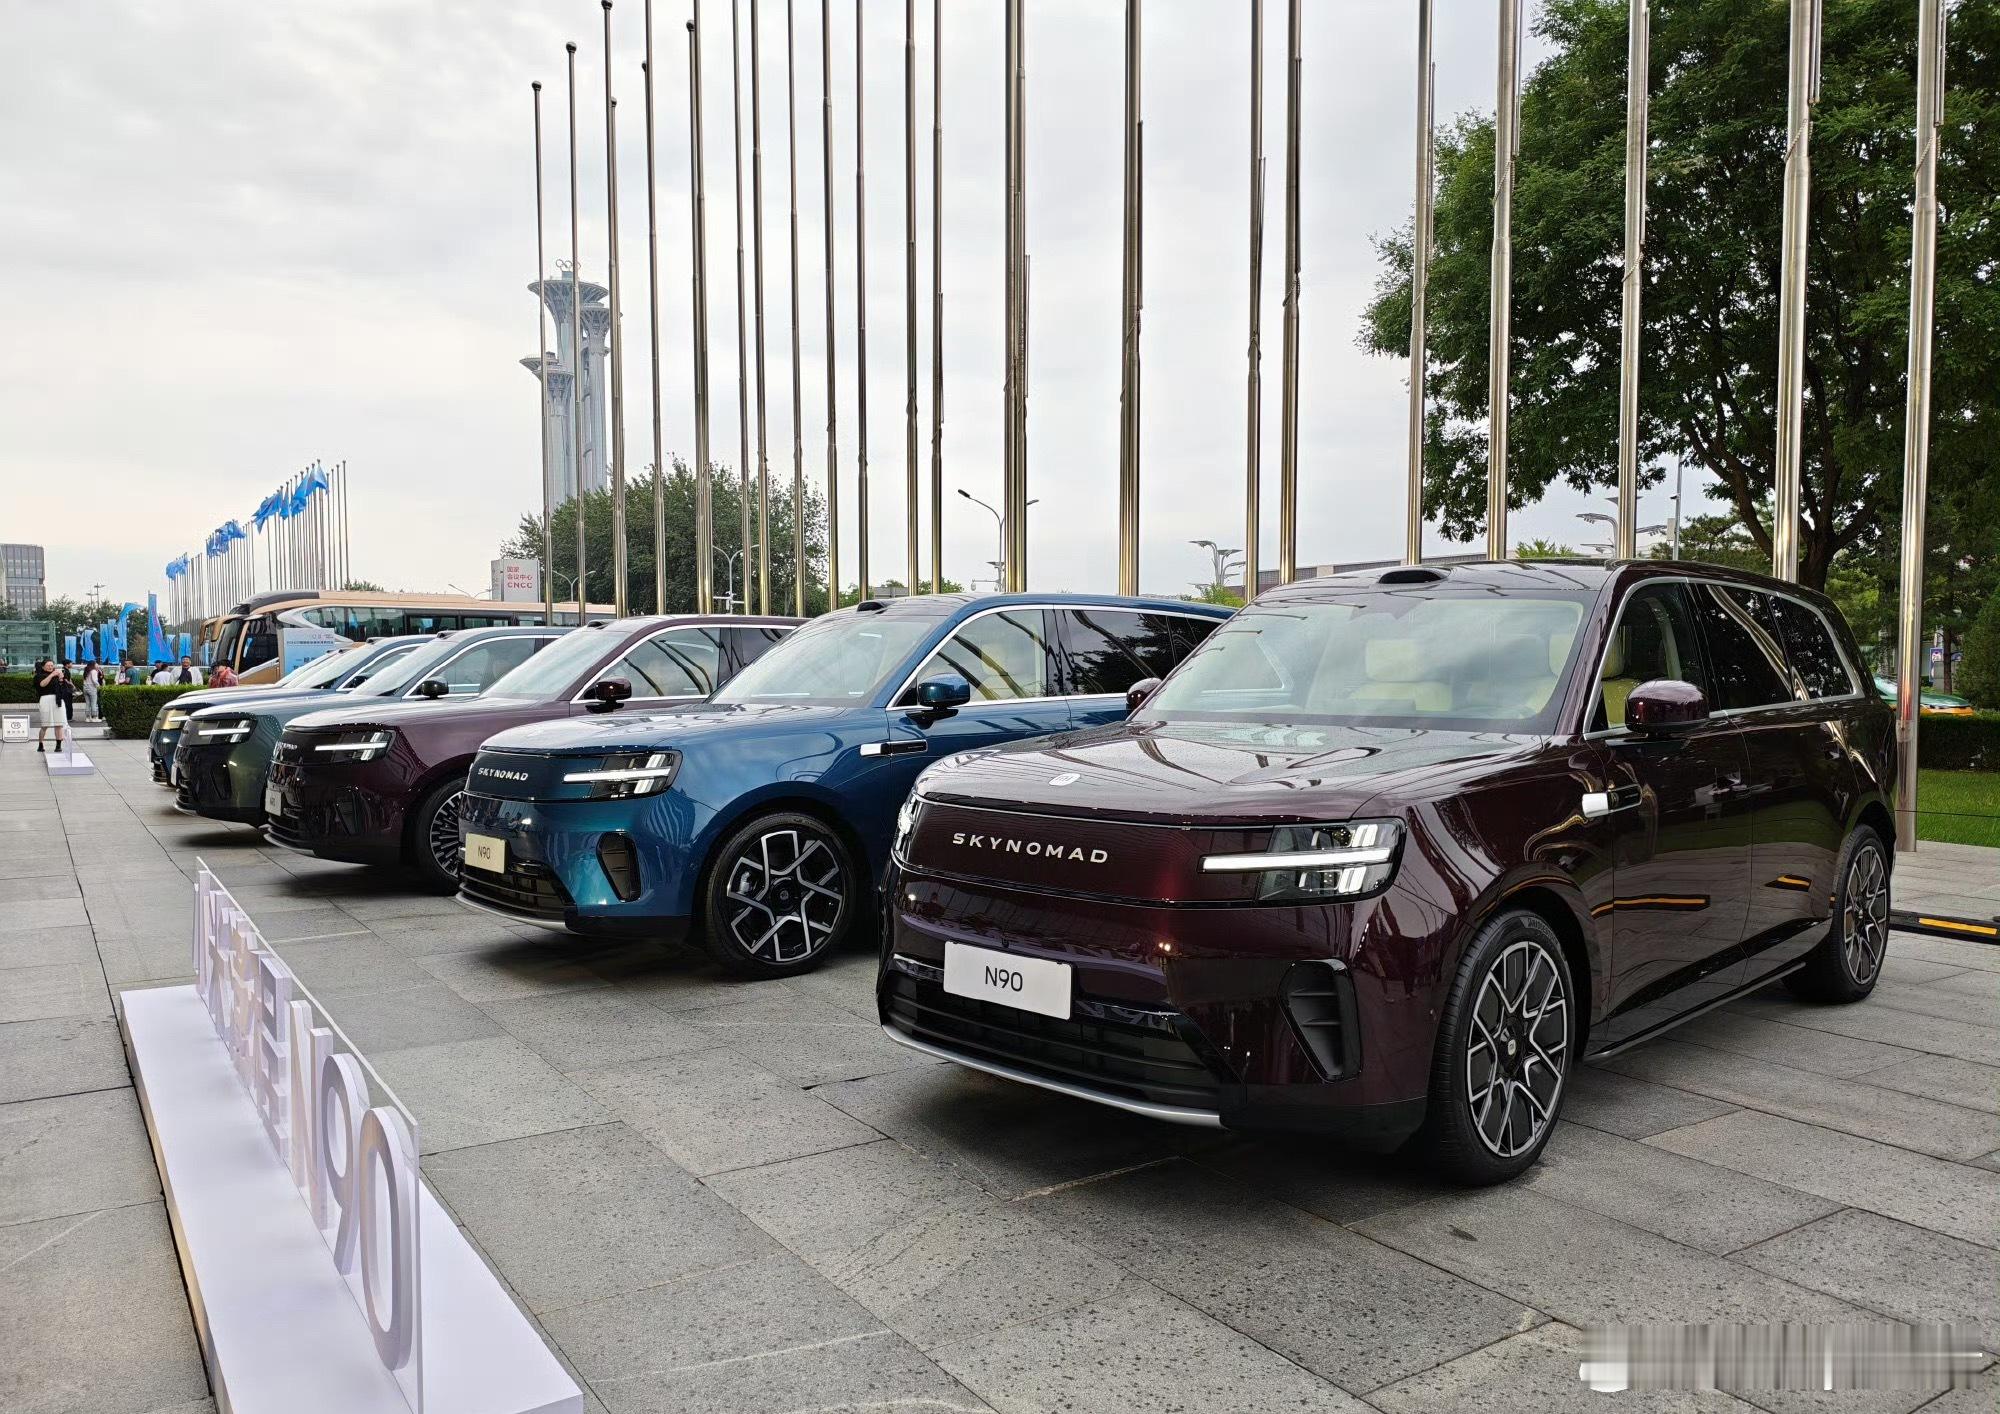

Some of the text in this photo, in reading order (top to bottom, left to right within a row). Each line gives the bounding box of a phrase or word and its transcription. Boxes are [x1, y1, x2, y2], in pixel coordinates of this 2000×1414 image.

[478, 767, 529, 781] SKYNOMAD
[478, 846, 491, 860] N90
[952, 831, 1109, 864] SKYNOMAD
[984, 965, 1024, 992] N90
[290, 1000, 413, 1372] N90
